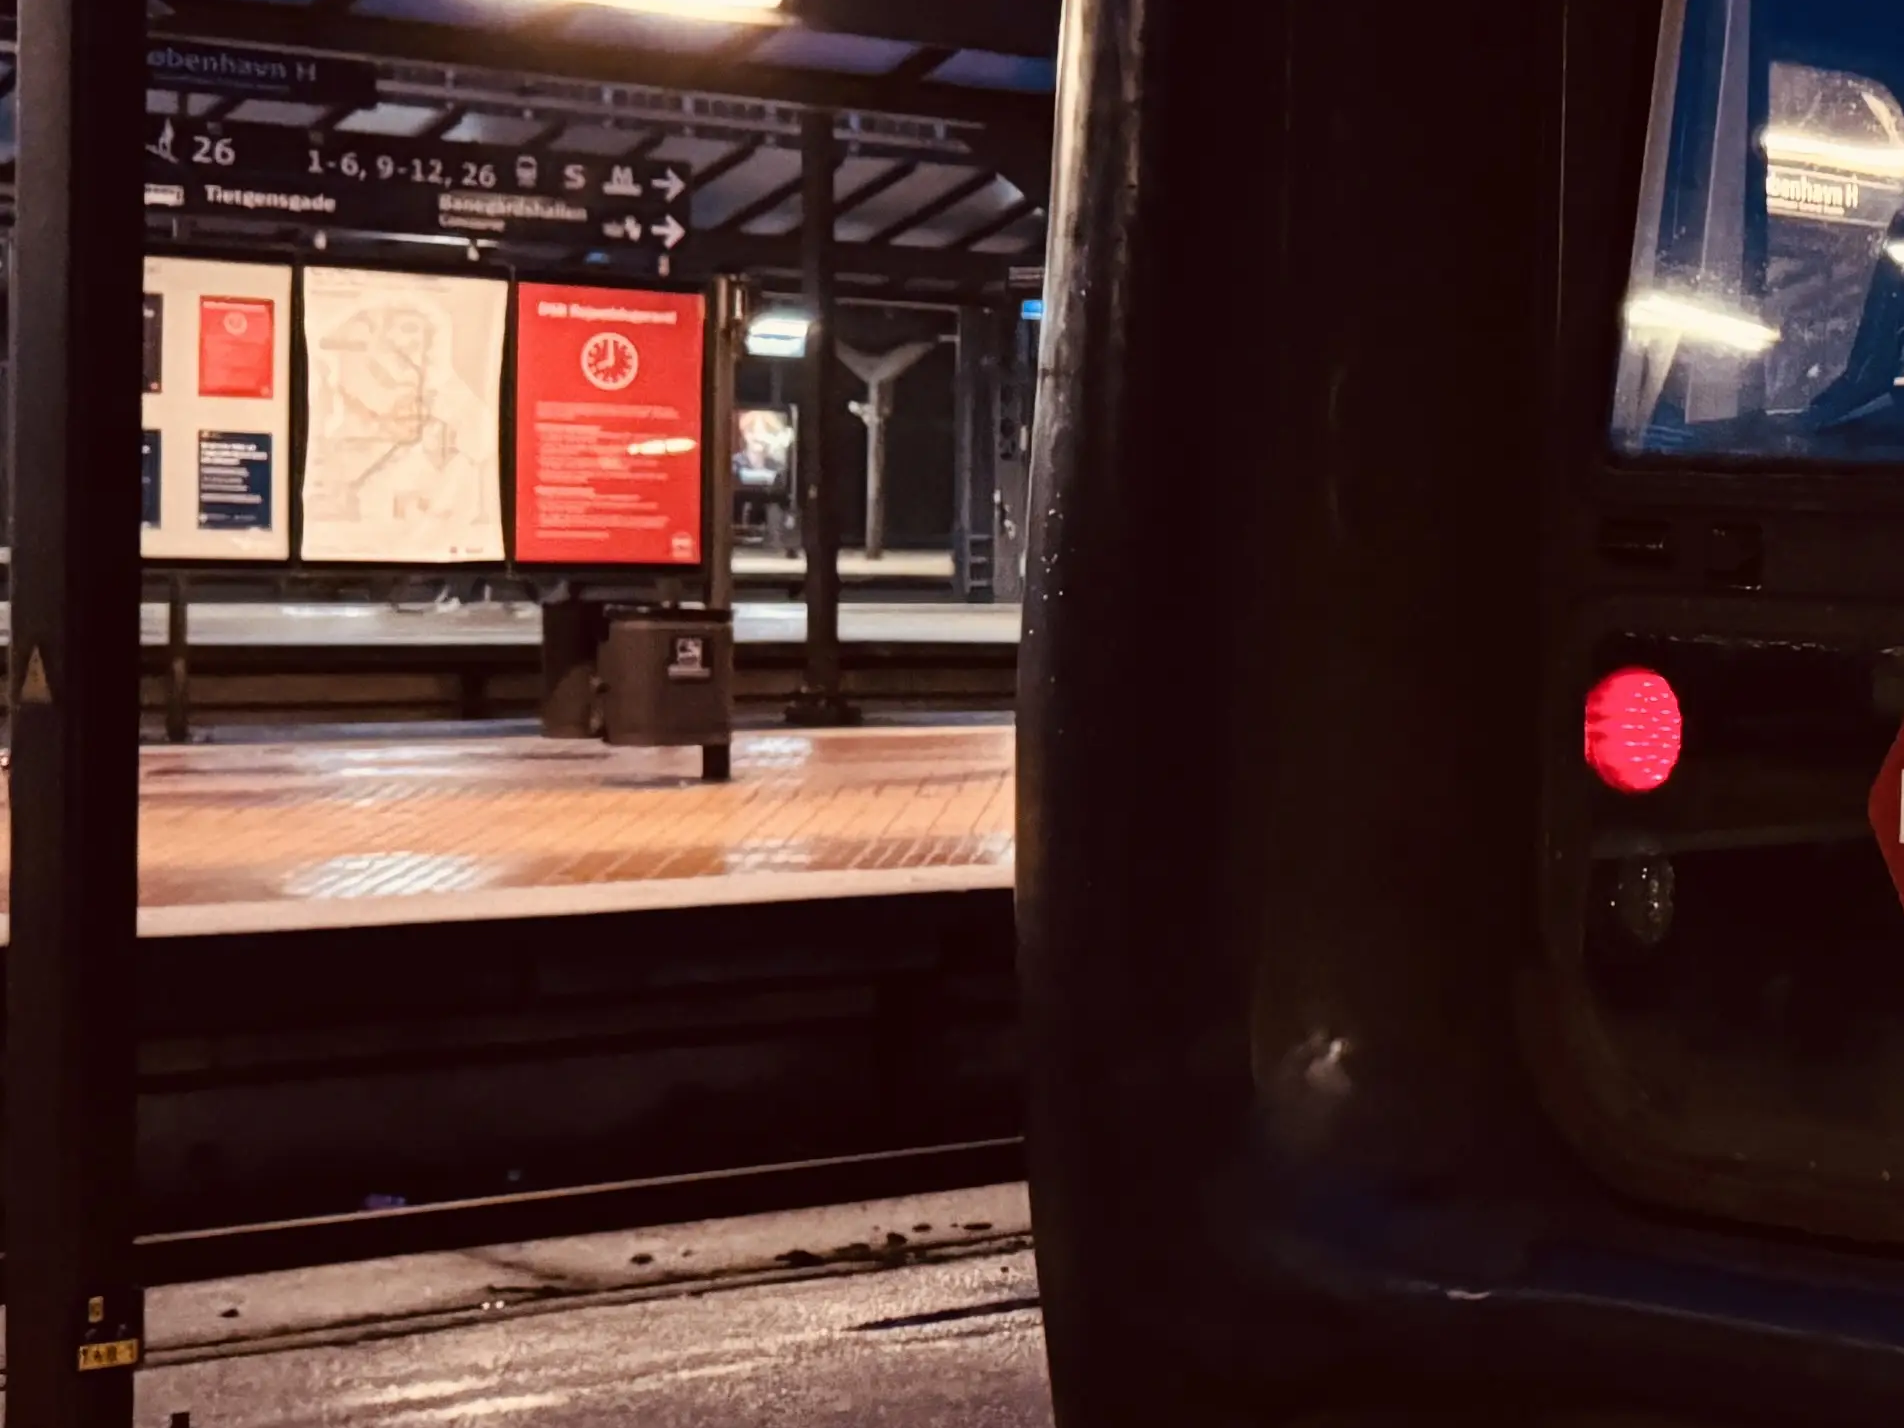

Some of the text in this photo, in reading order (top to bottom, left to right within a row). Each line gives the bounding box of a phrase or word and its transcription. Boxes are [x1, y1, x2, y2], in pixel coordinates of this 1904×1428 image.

[146, 47, 286, 80] øbenhavn
[192, 135, 236, 166] 26
[308, 149, 497, 189] 1-6, 9-12, 26
